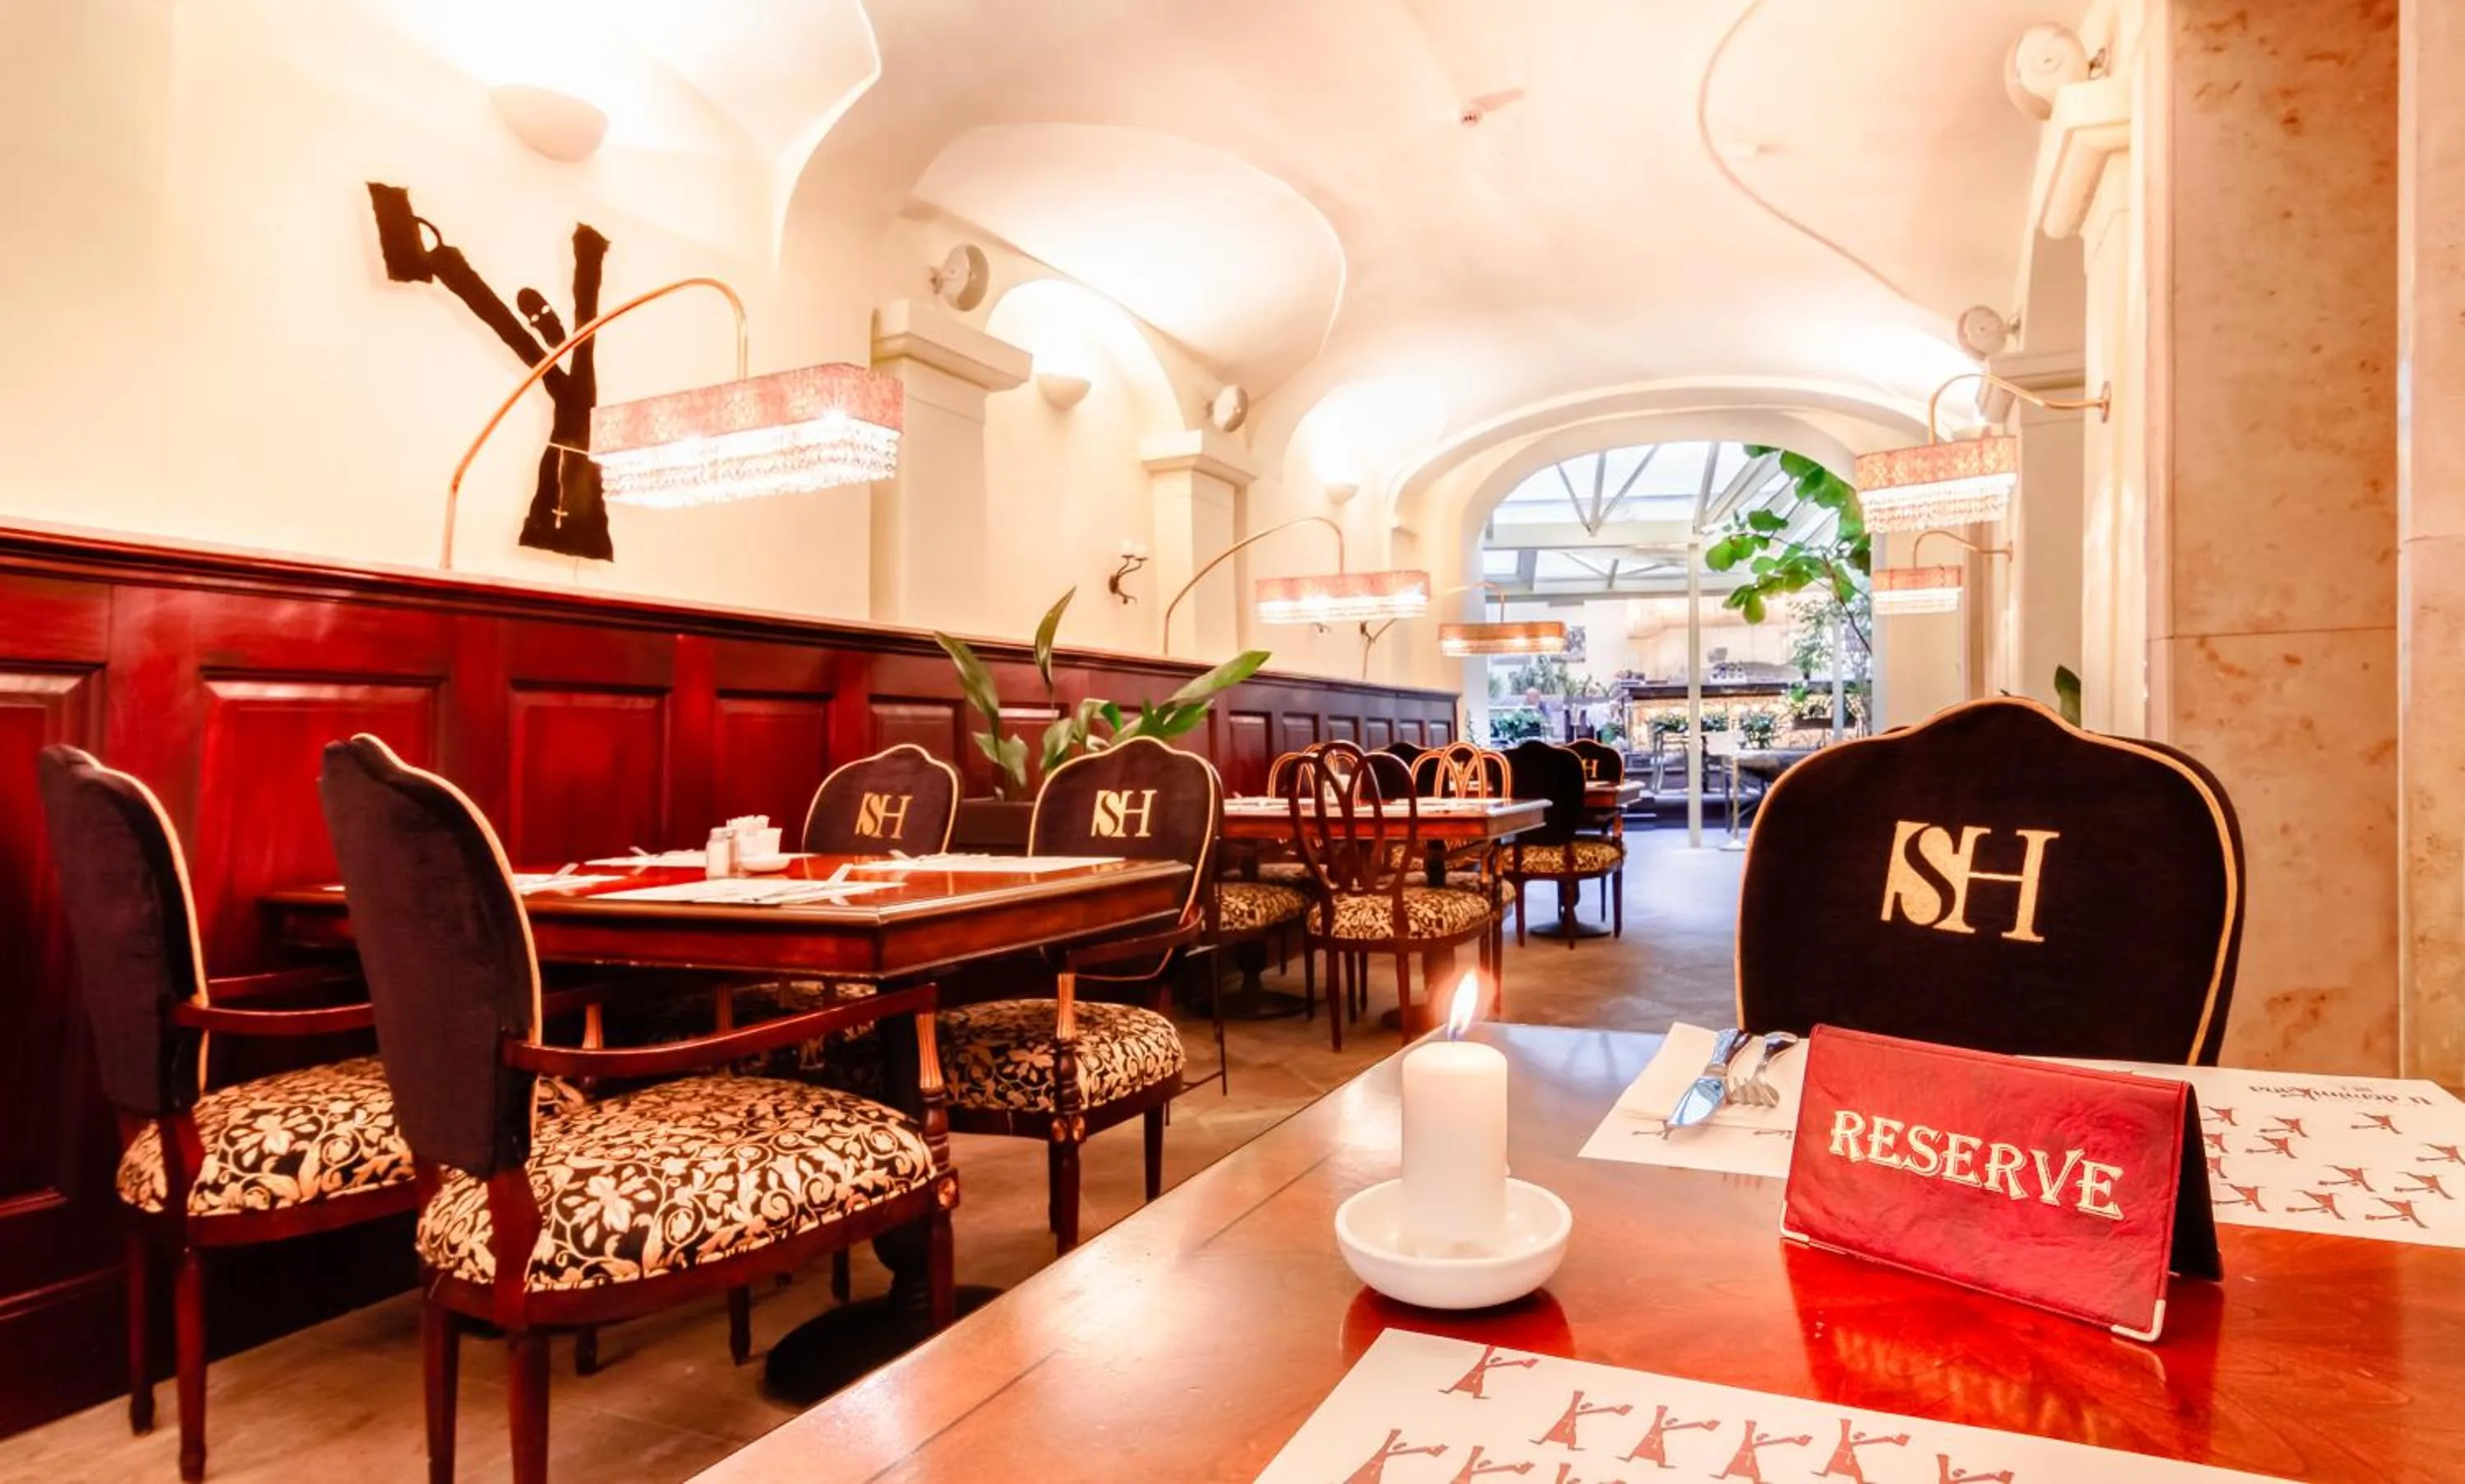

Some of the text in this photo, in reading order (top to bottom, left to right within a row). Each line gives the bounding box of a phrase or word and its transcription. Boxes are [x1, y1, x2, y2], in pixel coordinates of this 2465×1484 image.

[855, 792, 913, 839] SH
[1090, 790, 1157, 837] SH
[1881, 820, 2060, 942] SH
[1828, 1109, 2124, 1220] RESERVE
